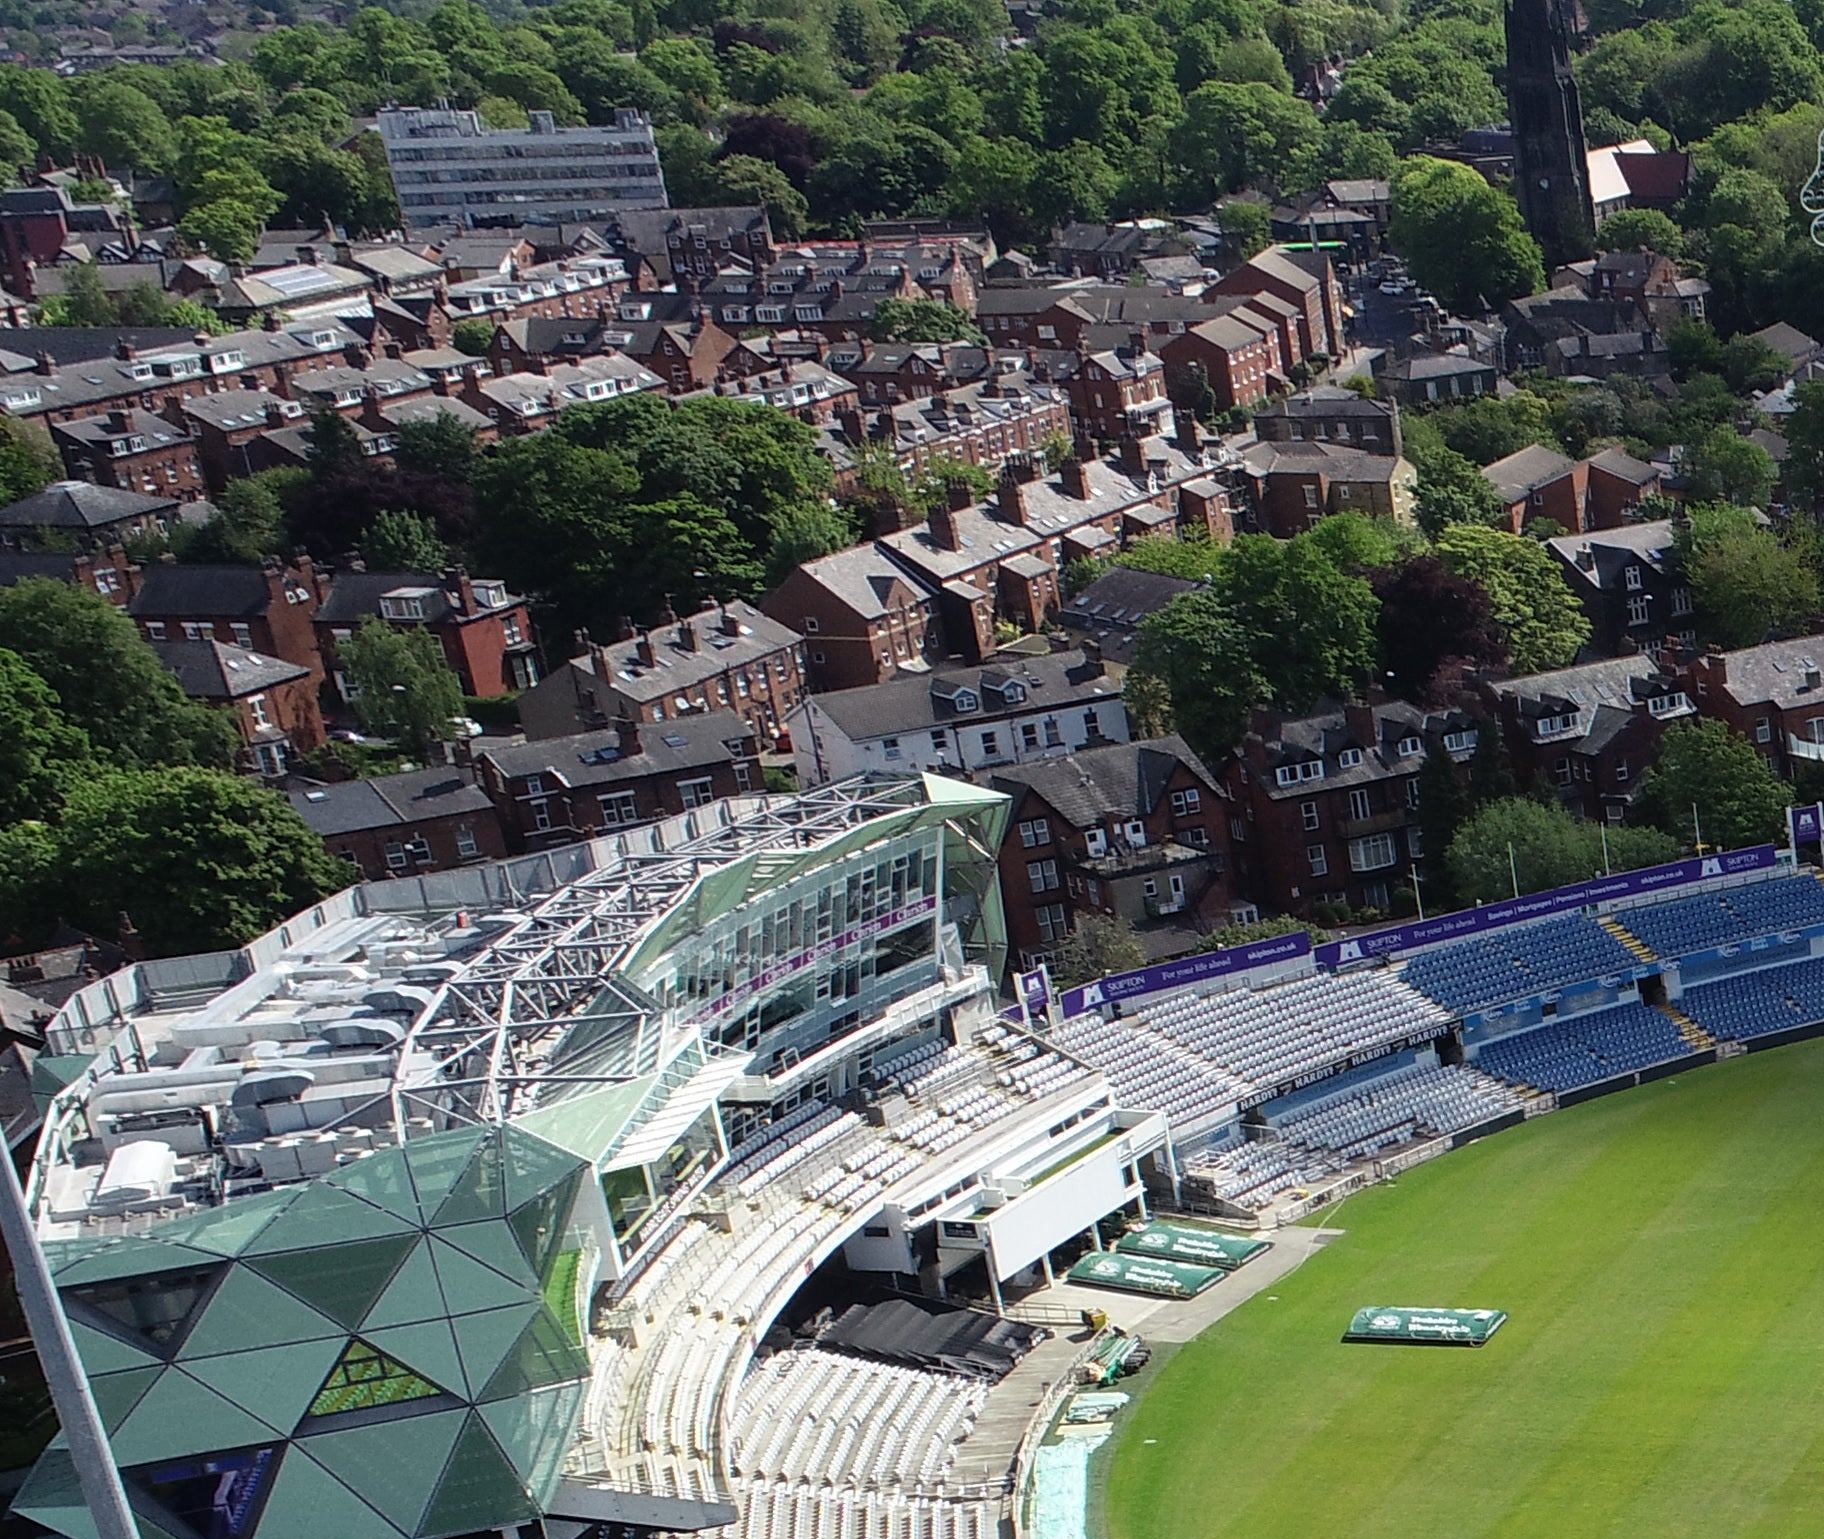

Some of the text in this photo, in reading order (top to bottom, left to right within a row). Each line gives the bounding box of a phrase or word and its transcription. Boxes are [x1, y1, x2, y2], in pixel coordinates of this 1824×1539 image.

[1726, 854, 1759, 866] SKIPTON
[1640, 870, 1684, 885] skipton.co.uk
[1488, 882, 1628, 920] Savings Mortgages Pensions Investments
[1413, 929, 1427, 940] For
[1428, 925, 1445, 938] your
[1454, 916, 1476, 929] ahead
[1367, 933, 1402, 948] SKIPTON
[1247, 943, 1296, 960] skipton.co.uk
[1161, 955, 1232, 981] For your life ahead
[1106, 974, 1145, 992] SKIPTON
[1408, 1026, 1447, 1046] HARDYS
[1352, 1046, 1391, 1066] HARDYS
